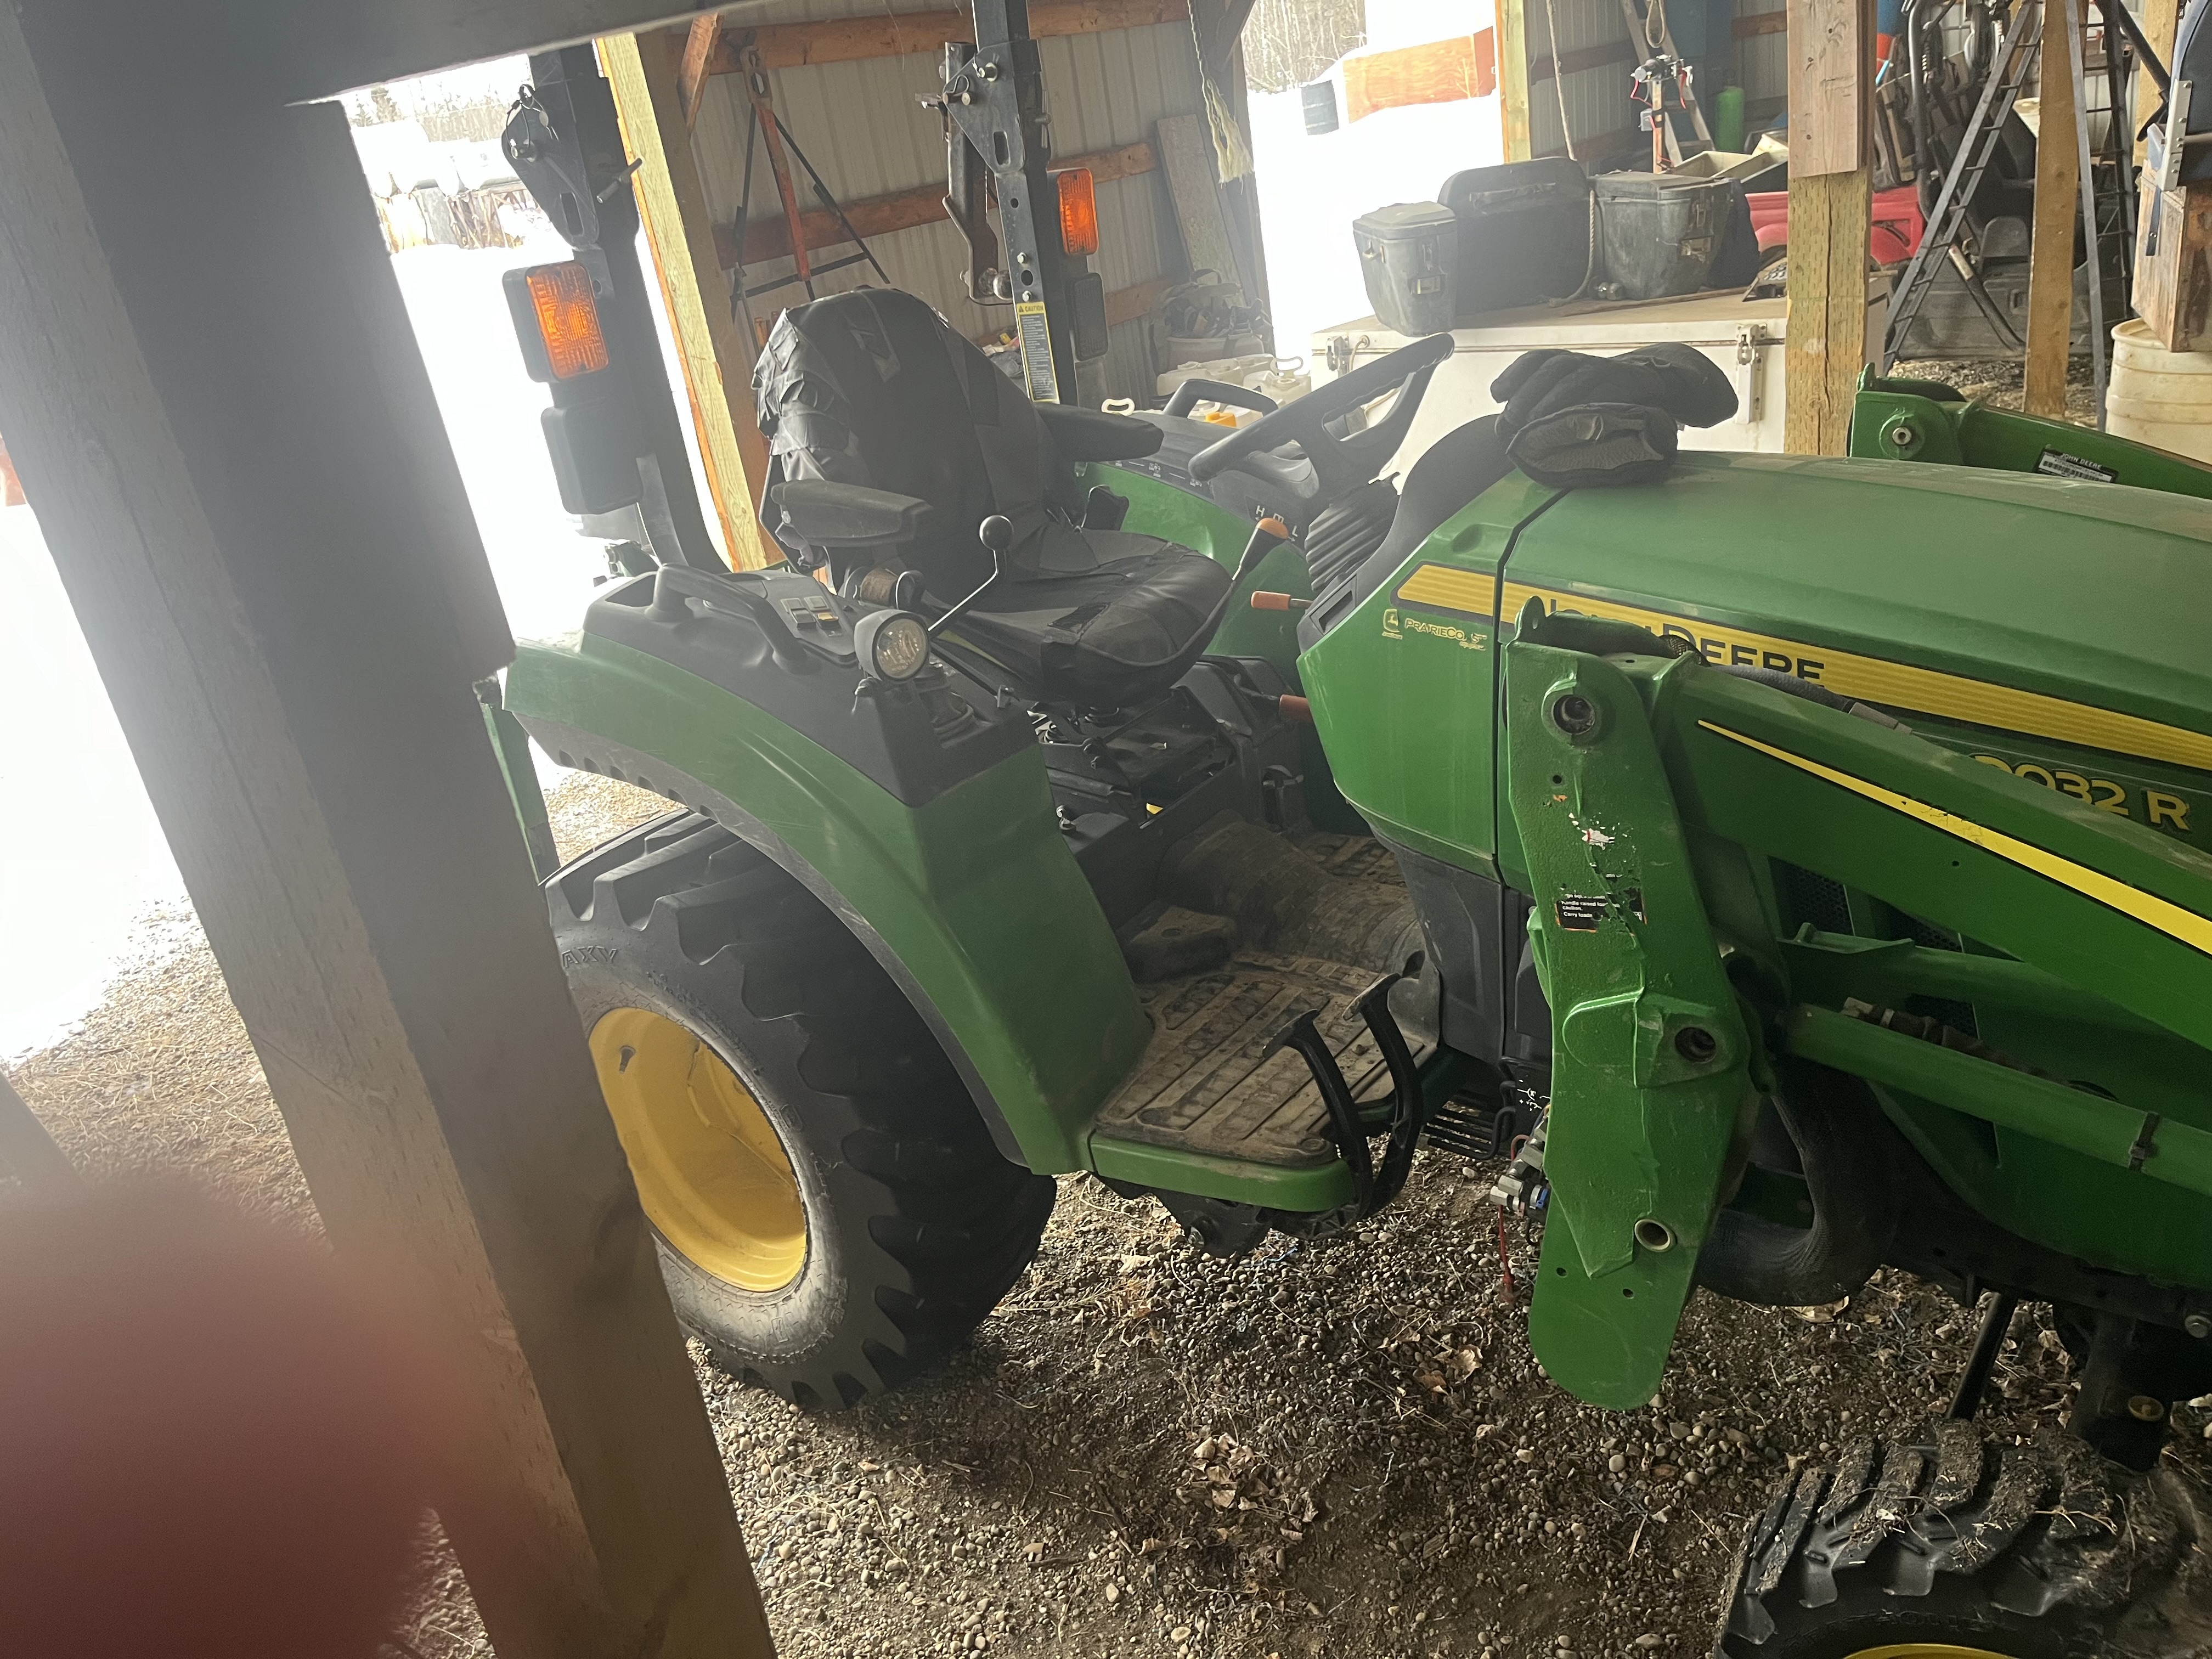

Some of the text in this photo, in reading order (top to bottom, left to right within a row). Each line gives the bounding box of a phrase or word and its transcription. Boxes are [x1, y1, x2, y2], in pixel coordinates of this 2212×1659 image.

[2061, 453, 2079, 462] JOHN
[2080, 458, 2102, 470] DEERE
[1256, 505, 1265, 517] H
[2147, 790, 2191, 830] R
